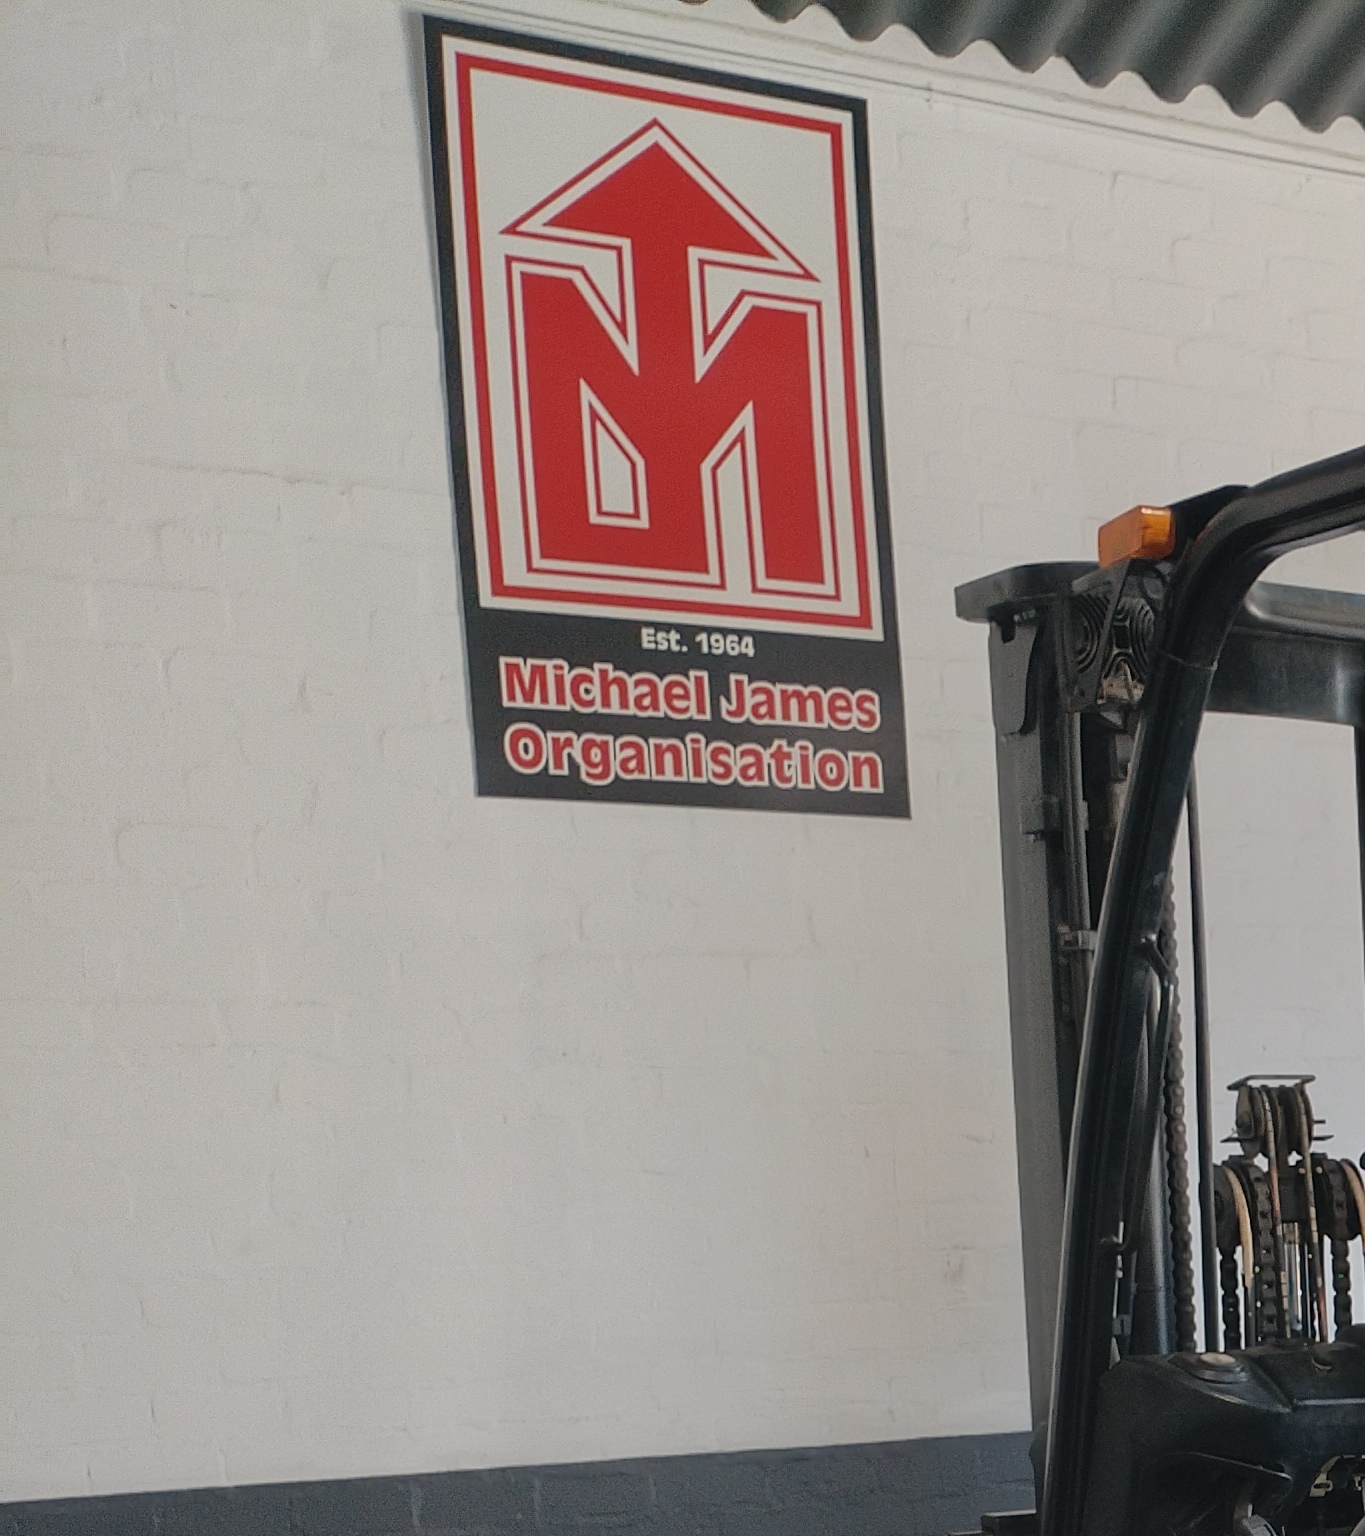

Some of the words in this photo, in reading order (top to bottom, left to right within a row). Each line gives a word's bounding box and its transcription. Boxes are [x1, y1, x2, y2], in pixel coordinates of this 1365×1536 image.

[640, 626, 688, 653] Est.
[695, 631, 755, 657] 1964
[500, 655, 711, 720] Michael
[720, 674, 880, 732] James
[503, 721, 884, 793] Organisation
